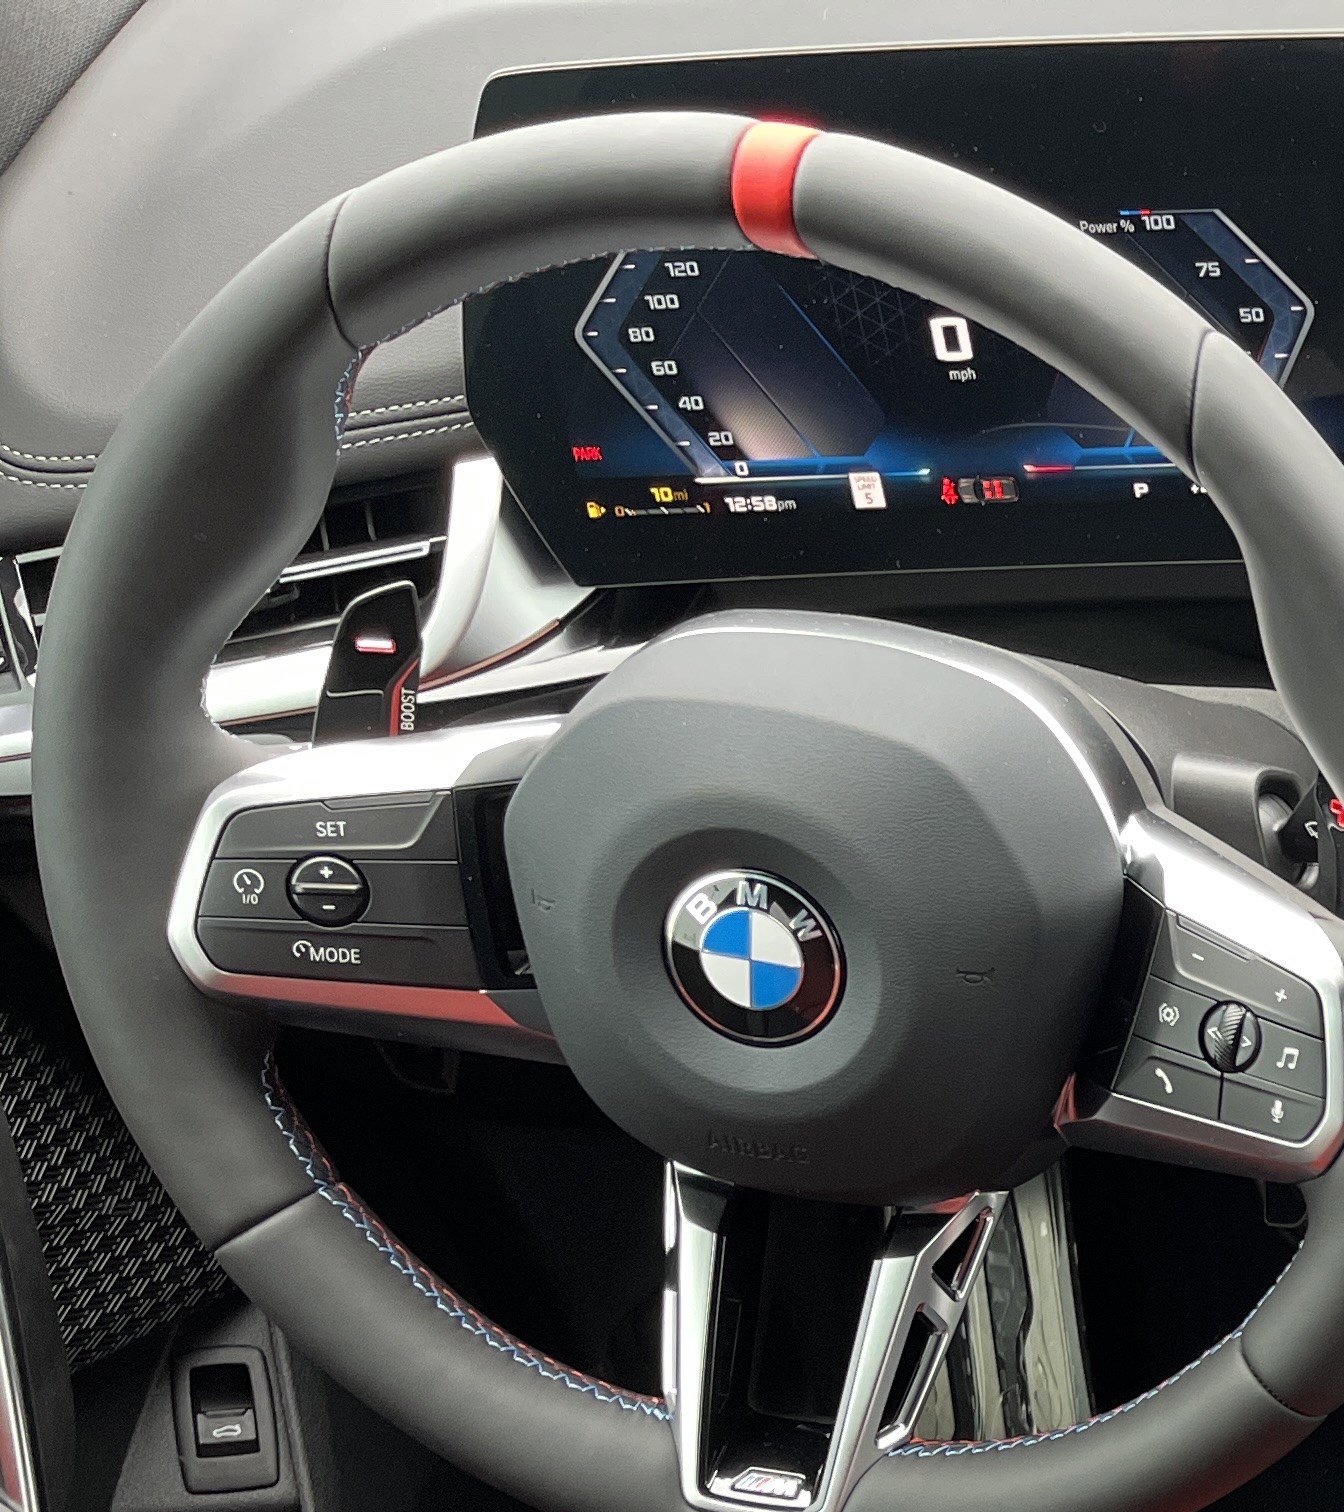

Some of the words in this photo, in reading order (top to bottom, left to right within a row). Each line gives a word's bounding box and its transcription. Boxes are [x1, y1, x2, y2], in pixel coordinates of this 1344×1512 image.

[1079, 219, 1119, 234] Power
[1120, 219, 1135, 233] %
[1141, 214, 1176, 231] 100
[664, 262, 700, 277] 120
[1195, 262, 1221, 277] 75
[643, 294, 680, 310] 100
[1238, 307, 1265, 323] 50
[627, 327, 655, 342] 80
[930, 316, 974, 362] 0
[651, 360, 678, 376] 60
[949, 367, 977, 382] mph
[678, 396, 704, 411] 40
[708, 431, 734, 446] 20
[572, 446, 602, 462] PARK
[734, 461, 749, 476] 0
[1133, 482, 1149, 498] P
[400, 687, 416, 731] BOOST
[315, 821, 347, 837] SET
[685, 880, 823, 942] BMW
[310, 946, 361, 964] MODE
